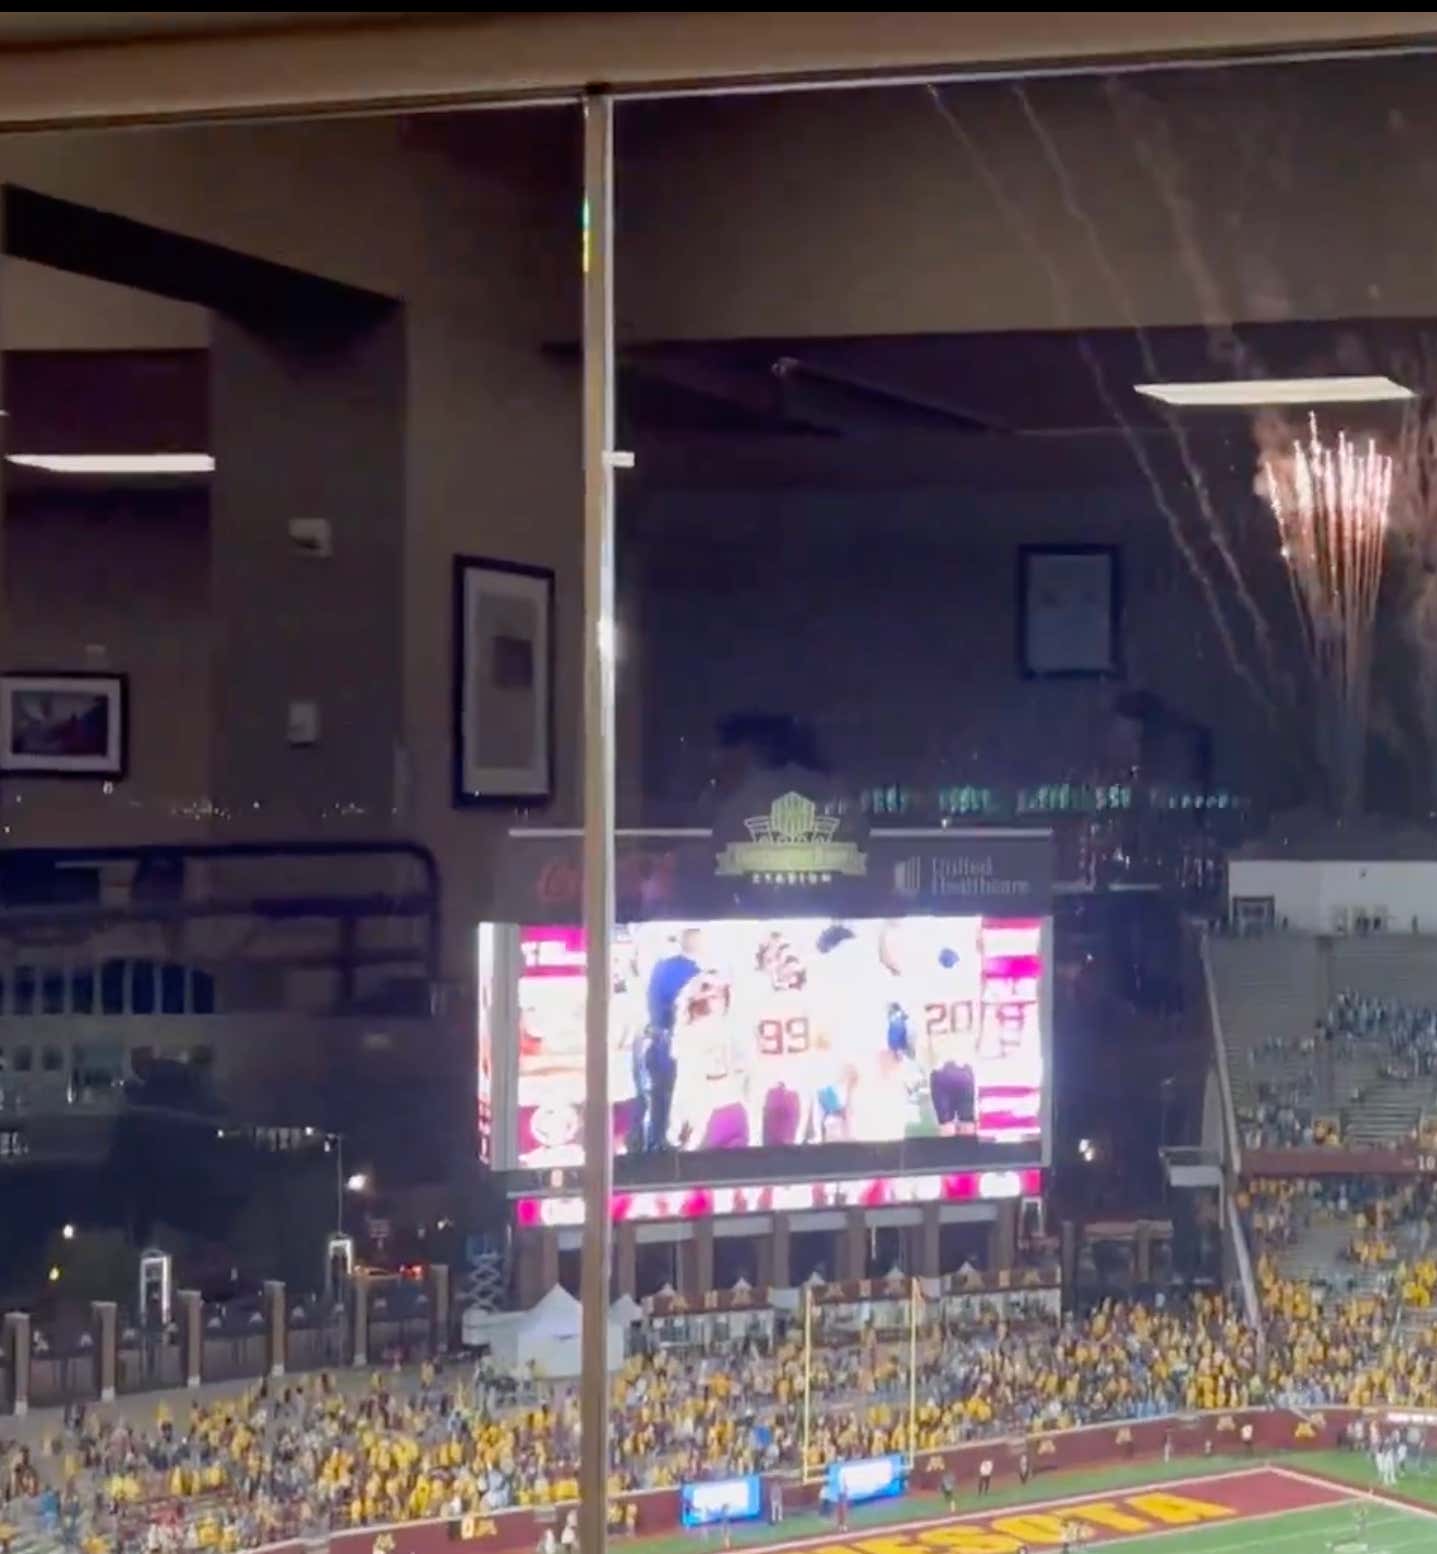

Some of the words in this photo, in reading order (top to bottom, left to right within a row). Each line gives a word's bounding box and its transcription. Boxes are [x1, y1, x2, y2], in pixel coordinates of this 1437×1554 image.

[931, 856, 993, 877] United
[931, 877, 1031, 896] Healthcare
[925, 1000, 974, 1034] 20
[758, 1017, 809, 1055] 99
